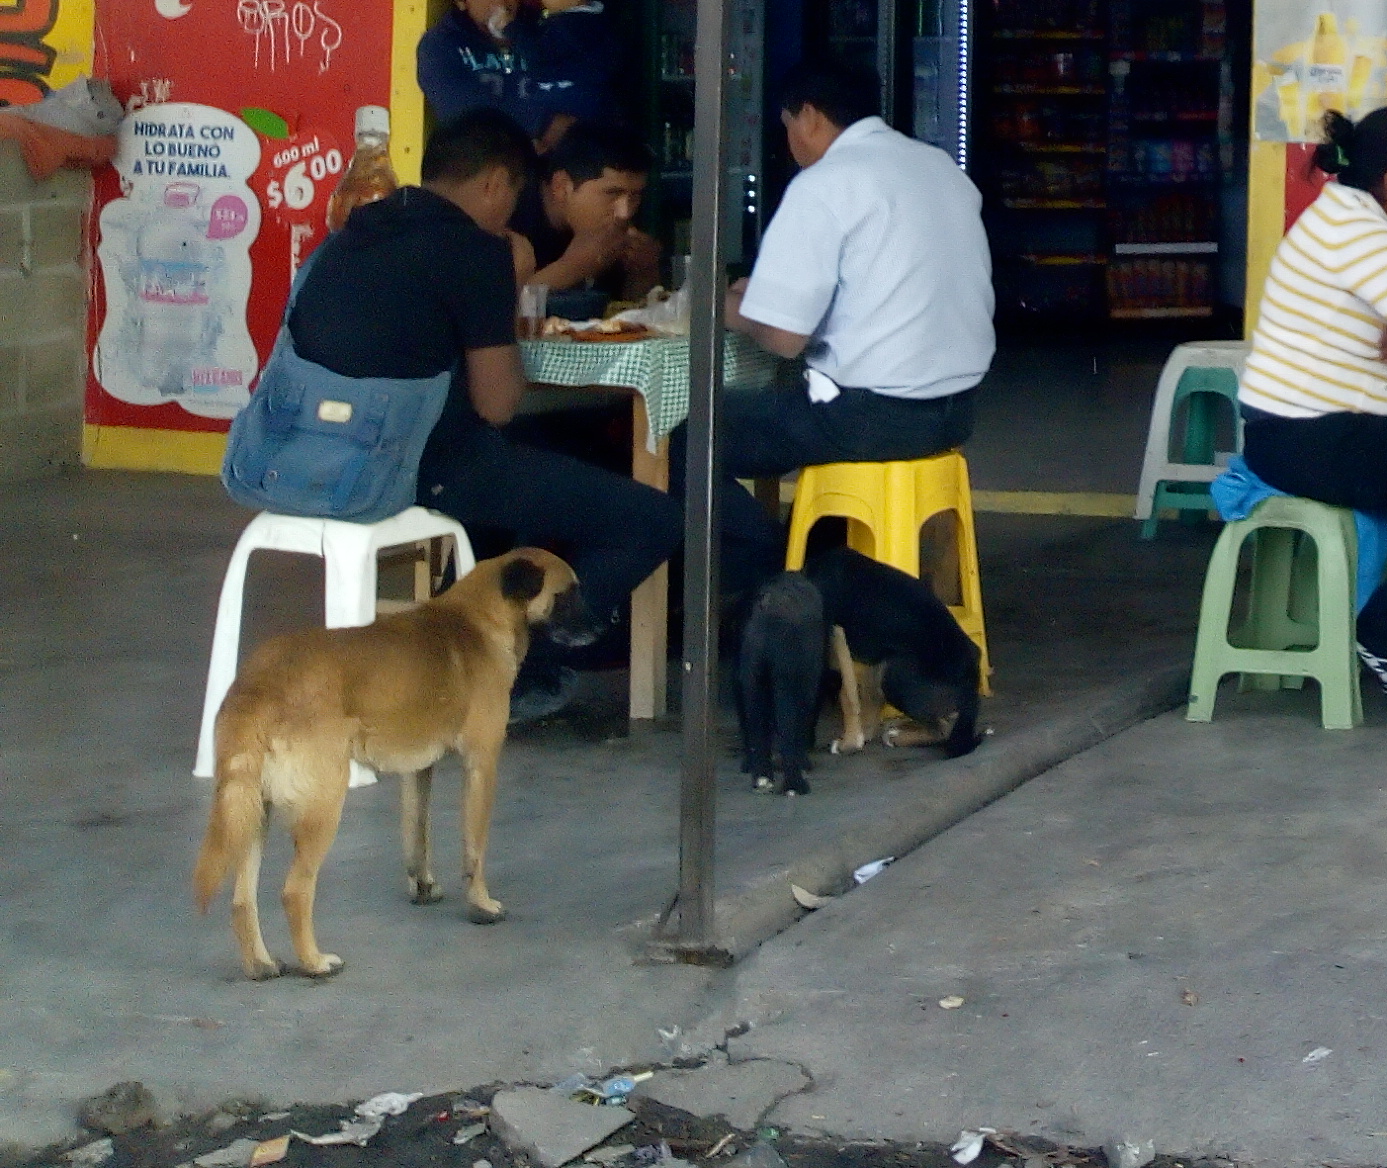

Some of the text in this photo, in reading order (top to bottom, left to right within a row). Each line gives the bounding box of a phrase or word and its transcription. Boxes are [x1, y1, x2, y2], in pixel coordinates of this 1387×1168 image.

[133, 120, 235, 141] HIDRATA CON
[144, 141, 221, 159] LO BUENO
[273, 134, 320, 168] 600 ml
[133, 160, 143, 176] A
[146, 159, 165, 175] TU
